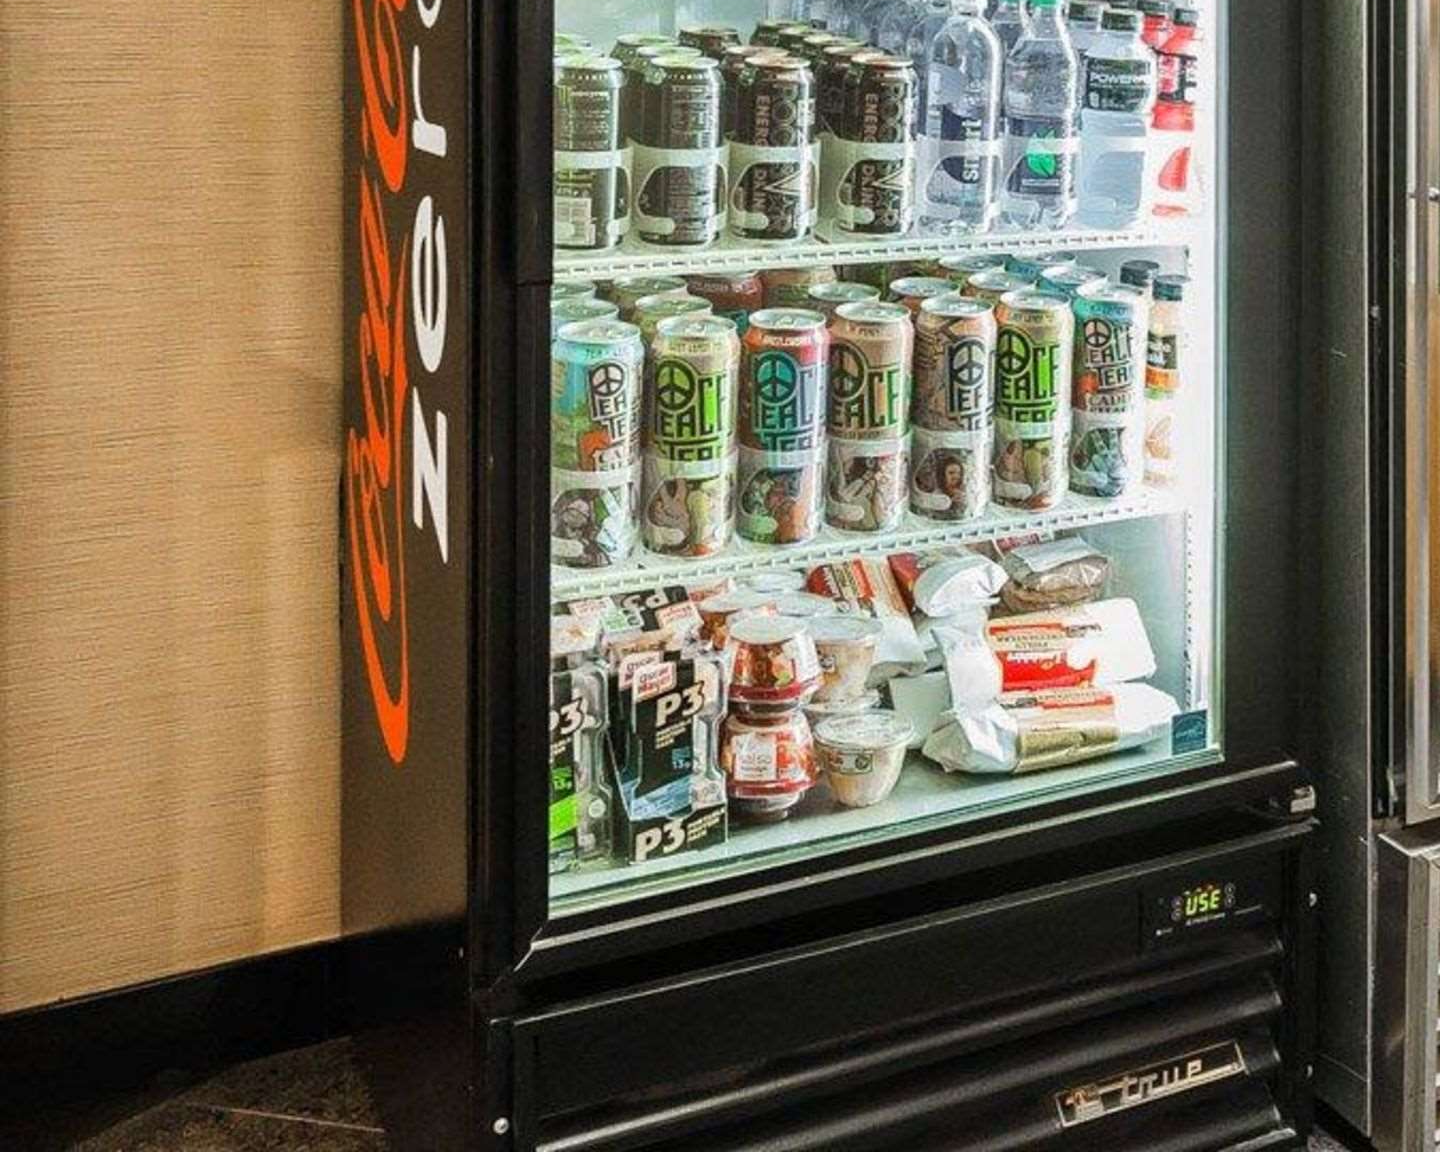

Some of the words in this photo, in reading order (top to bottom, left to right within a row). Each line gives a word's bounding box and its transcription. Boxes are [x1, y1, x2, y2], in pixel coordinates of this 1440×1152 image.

[754, 94, 771, 147] ENERG
[863, 92, 880, 144] ENERG
[656, 680, 704, 727] P3
[634, 817, 686, 862] P3
[1185, 889, 1221, 916] USE
